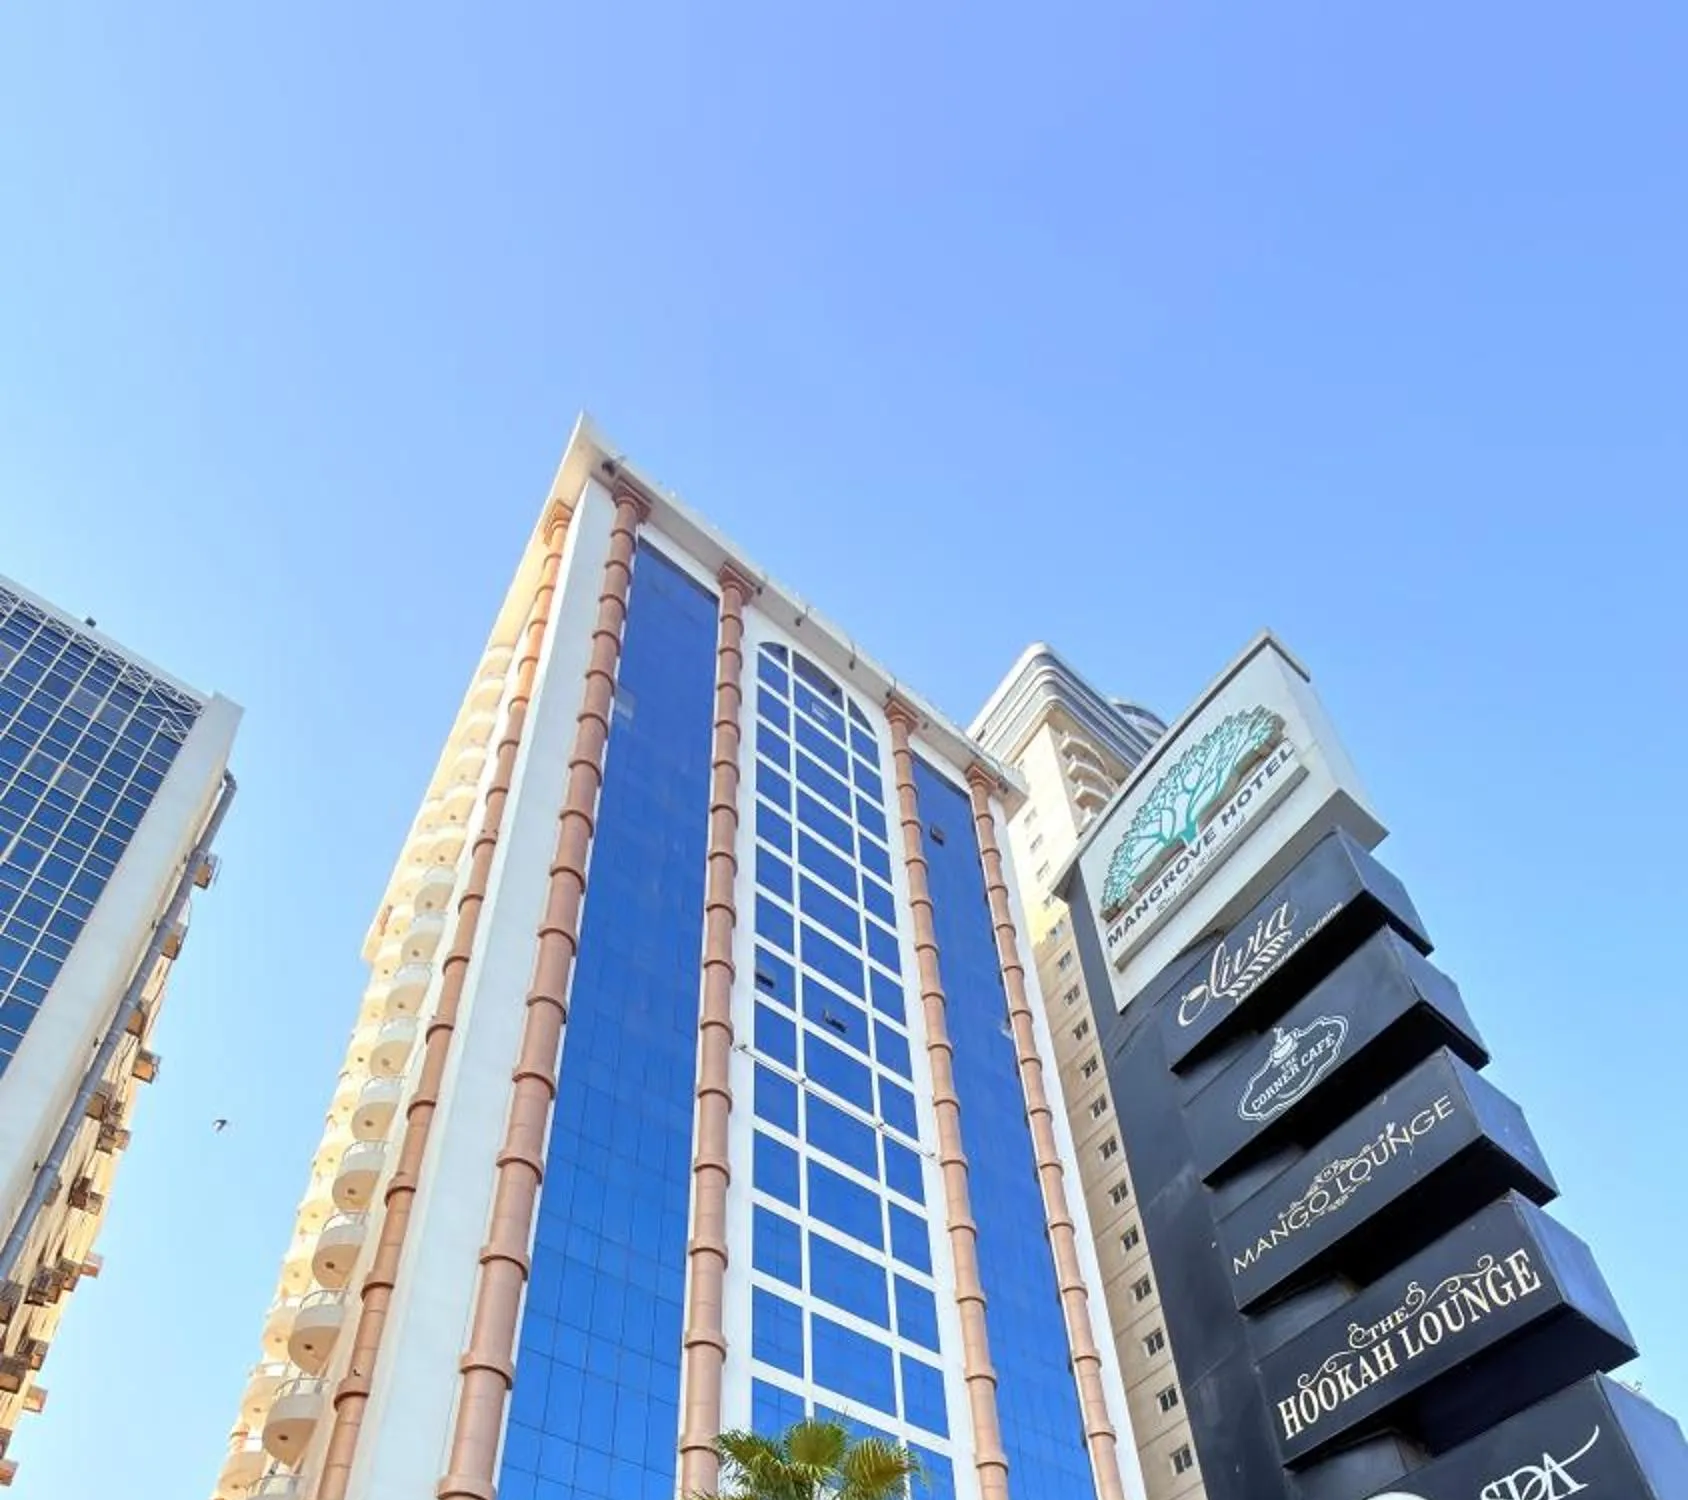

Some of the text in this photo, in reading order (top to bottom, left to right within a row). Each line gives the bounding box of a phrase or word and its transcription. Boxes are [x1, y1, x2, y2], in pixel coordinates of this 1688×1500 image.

[1106, 829, 1218, 949] MANGROVE
[1221, 744, 1296, 827] HOTEL
[1251, 1062, 1301, 1112] CORNER
[1232, 1095, 1456, 1275] MANGO LOUNGE
[1277, 1248, 1542, 1440] HOOKAH LOUNGE
[1366, 1304, 1410, 1343] THE
